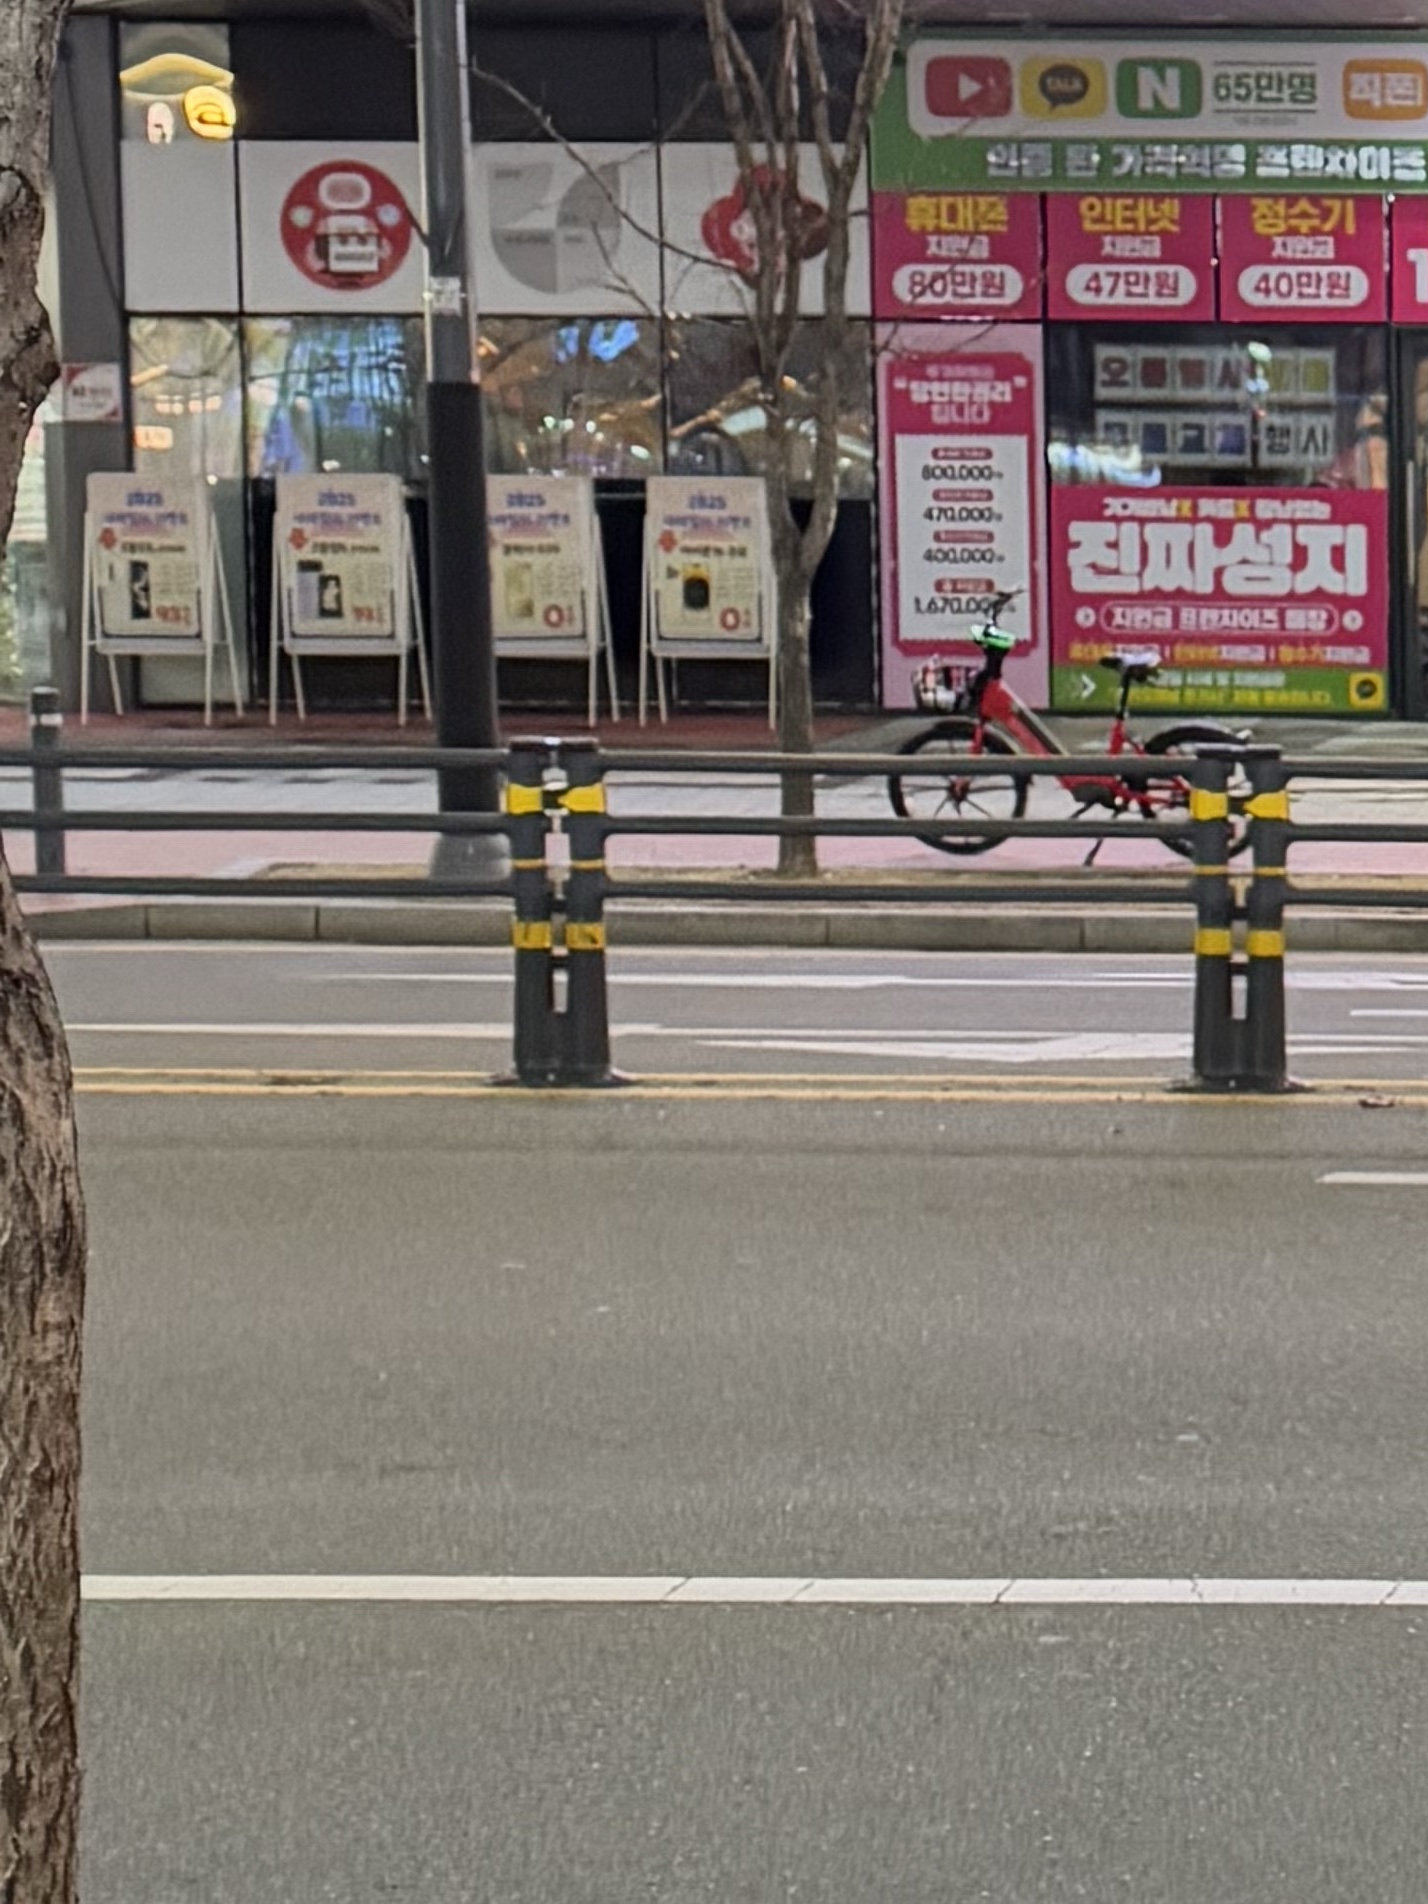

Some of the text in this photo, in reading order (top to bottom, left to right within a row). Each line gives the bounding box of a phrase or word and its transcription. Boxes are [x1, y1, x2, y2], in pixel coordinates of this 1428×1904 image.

[1137, 66, 1181, 111] N
[1213, 70, 1317, 104] 65만명
[1079, 196, 1181, 232] 인터넷
[1083, 270, 1180, 297] 47만원
[1253, 271, 1352, 299] 40만원
